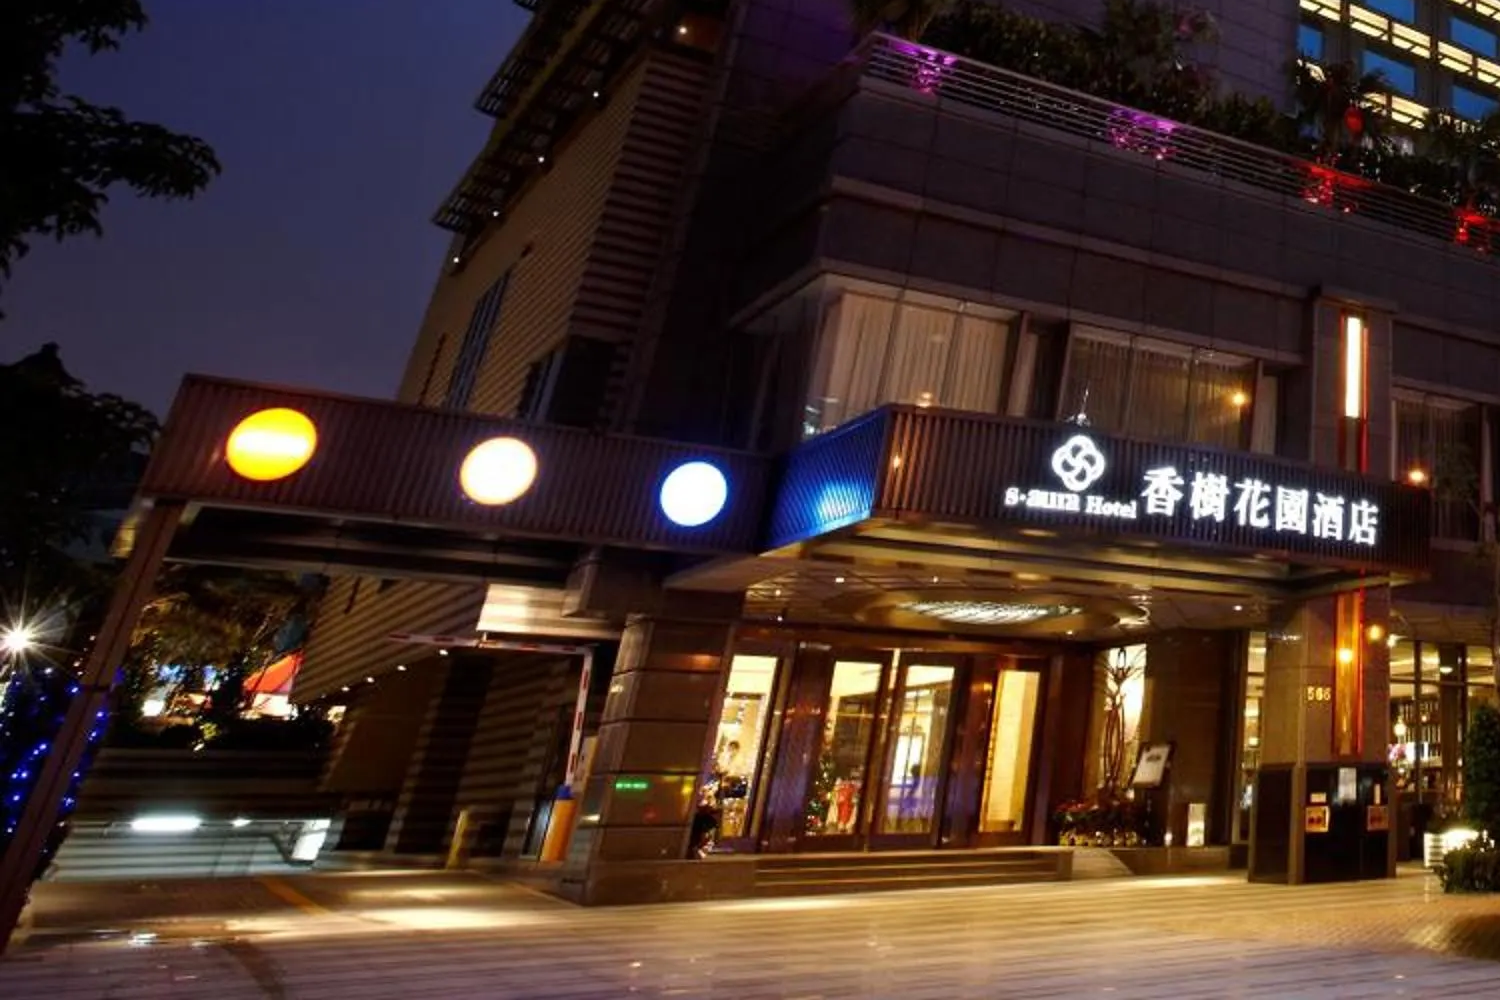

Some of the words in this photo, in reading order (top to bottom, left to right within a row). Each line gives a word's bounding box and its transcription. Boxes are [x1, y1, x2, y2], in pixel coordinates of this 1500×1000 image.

[1085, 495, 1137, 519] Hotel
[1141, 466, 1379, 546] 香樹花園酒店
